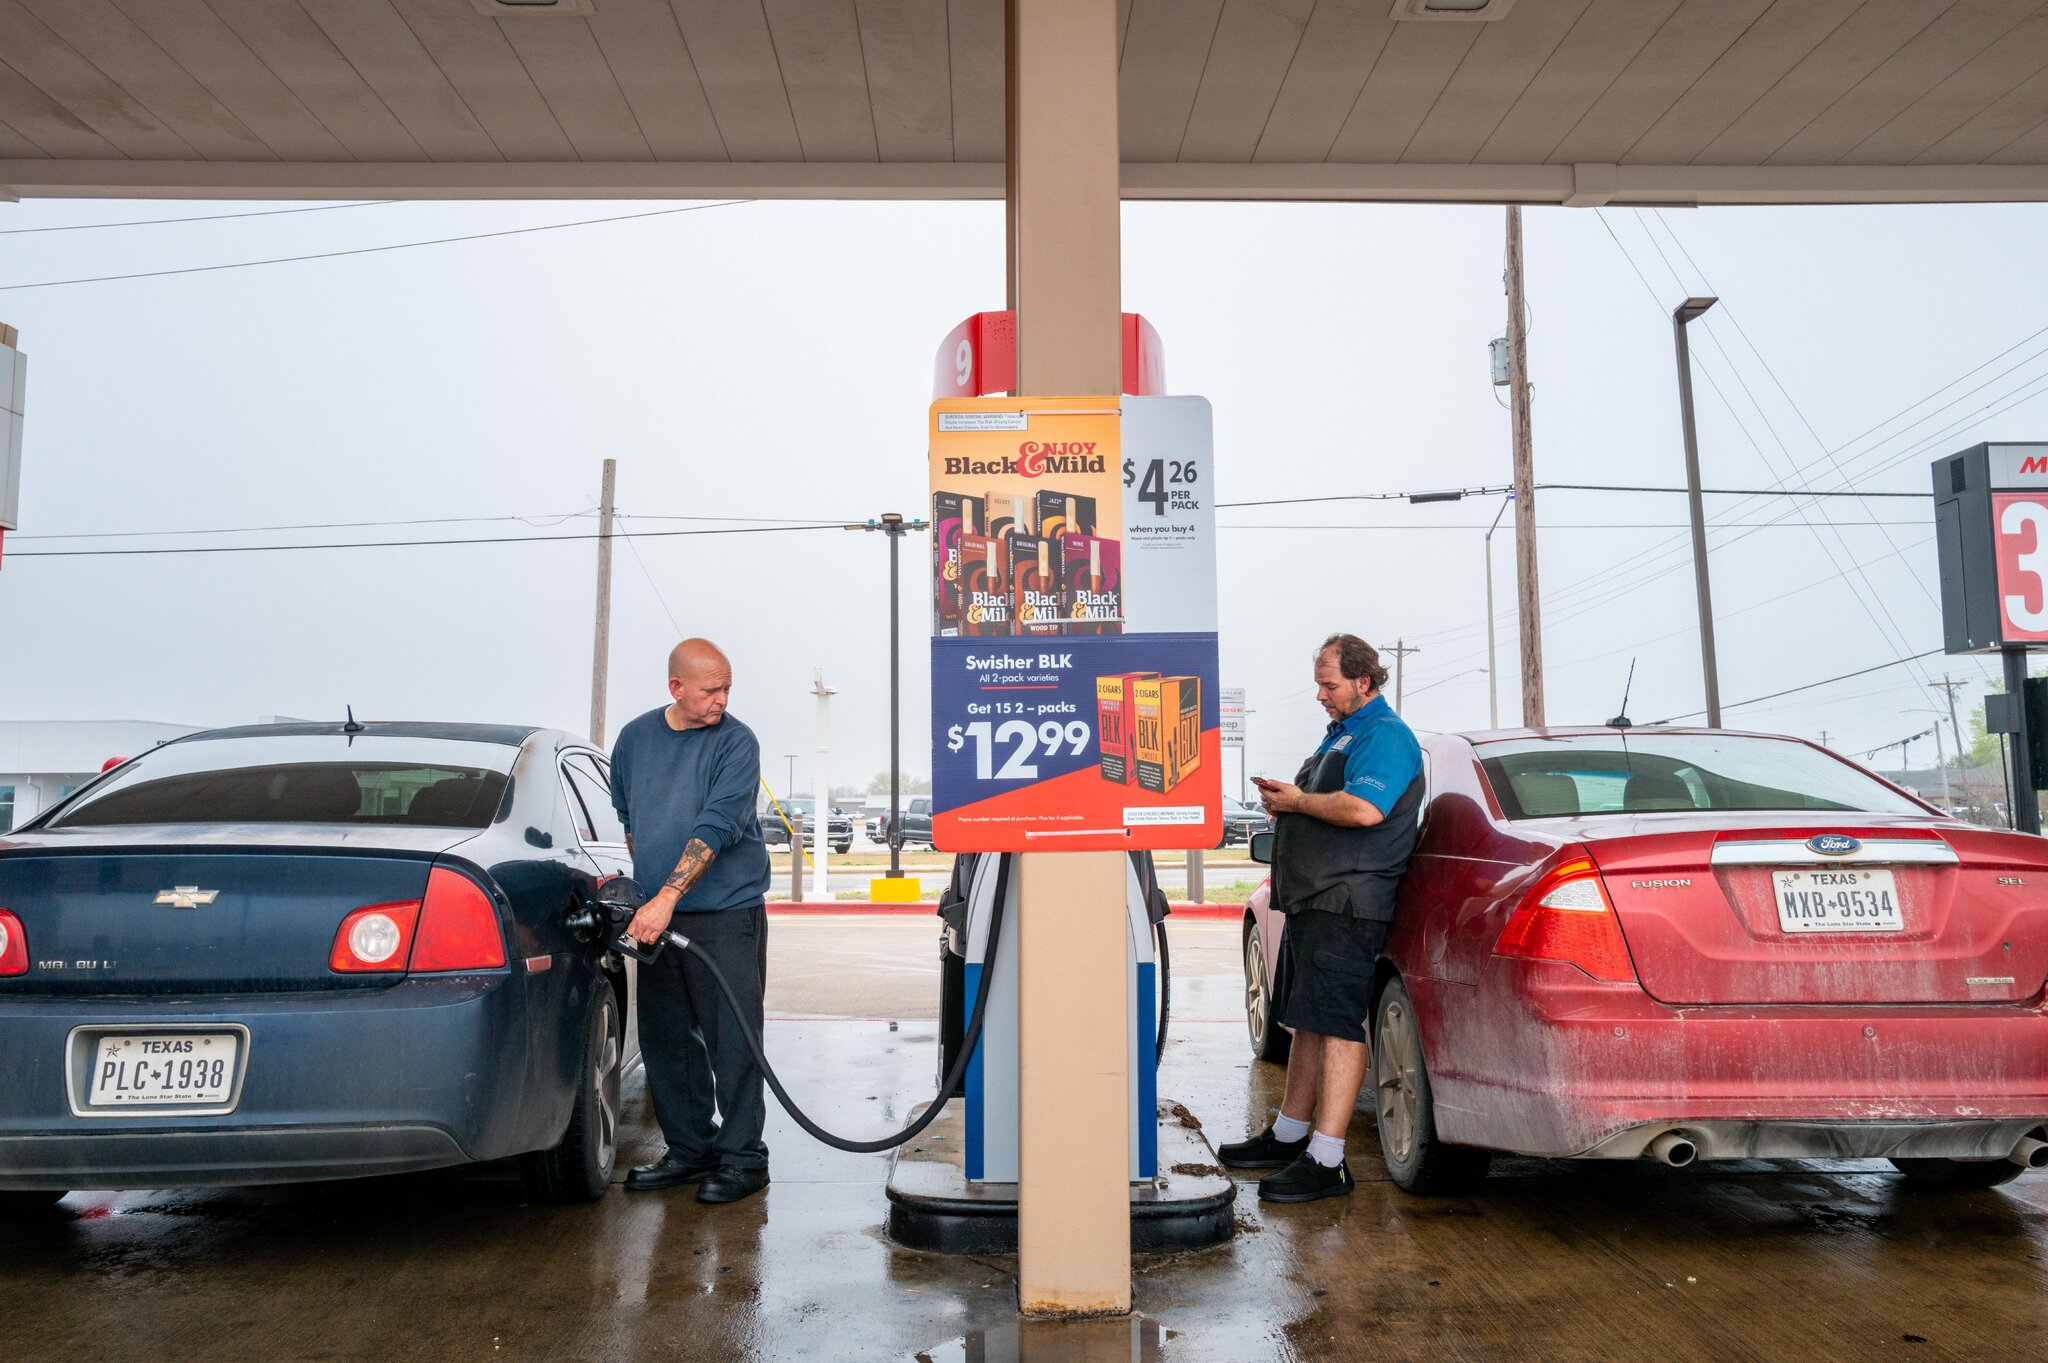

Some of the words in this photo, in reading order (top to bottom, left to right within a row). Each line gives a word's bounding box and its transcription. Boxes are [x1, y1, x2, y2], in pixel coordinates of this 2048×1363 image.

[956, 339, 972, 386] 9
[945, 456, 1018, 475] Black
[1044, 456, 1106, 474] Mild
[2019, 456, 2048, 474] M
[1171, 490, 1190, 499] PER
[1172, 501, 1199, 510] PACK
[1172, 525, 1187, 534] buy
[2001, 502, 2048, 632] 3
[1076, 590, 1117, 605] Black
[966, 654, 1033, 670] Swisher
[1039, 654, 1072, 668] BLK
[980, 674, 990, 682] All
[992, 673, 1024, 684] 2-pack
[1103, 685, 1121, 694] CIGARS
[1136, 689, 1138, 697] 2
[1140, 690, 1159, 698] CIGARS
[968, 703, 991, 714] Get
[996, 703, 1011, 713] 15
[1016, 703, 1023, 713] 2
[1038, 702, 1076, 715] packs
[1102, 714, 1121, 744] BLK
[1138, 720, 1158, 751] BLK
[1821, 837, 1850, 849] Ford
[1632, 879, 1691, 888] FUSION
[1810, 874, 1857, 885] TEXAS
[1998, 878, 2024, 886] SEL
[1784, 892, 1826, 918] MXB
[1837, 890, 1893, 917] 9534
[142, 1040, 193, 1054] TEXAS
[100, 1060, 148, 1091] PLC
[161, 1059, 224, 1089] 1938
